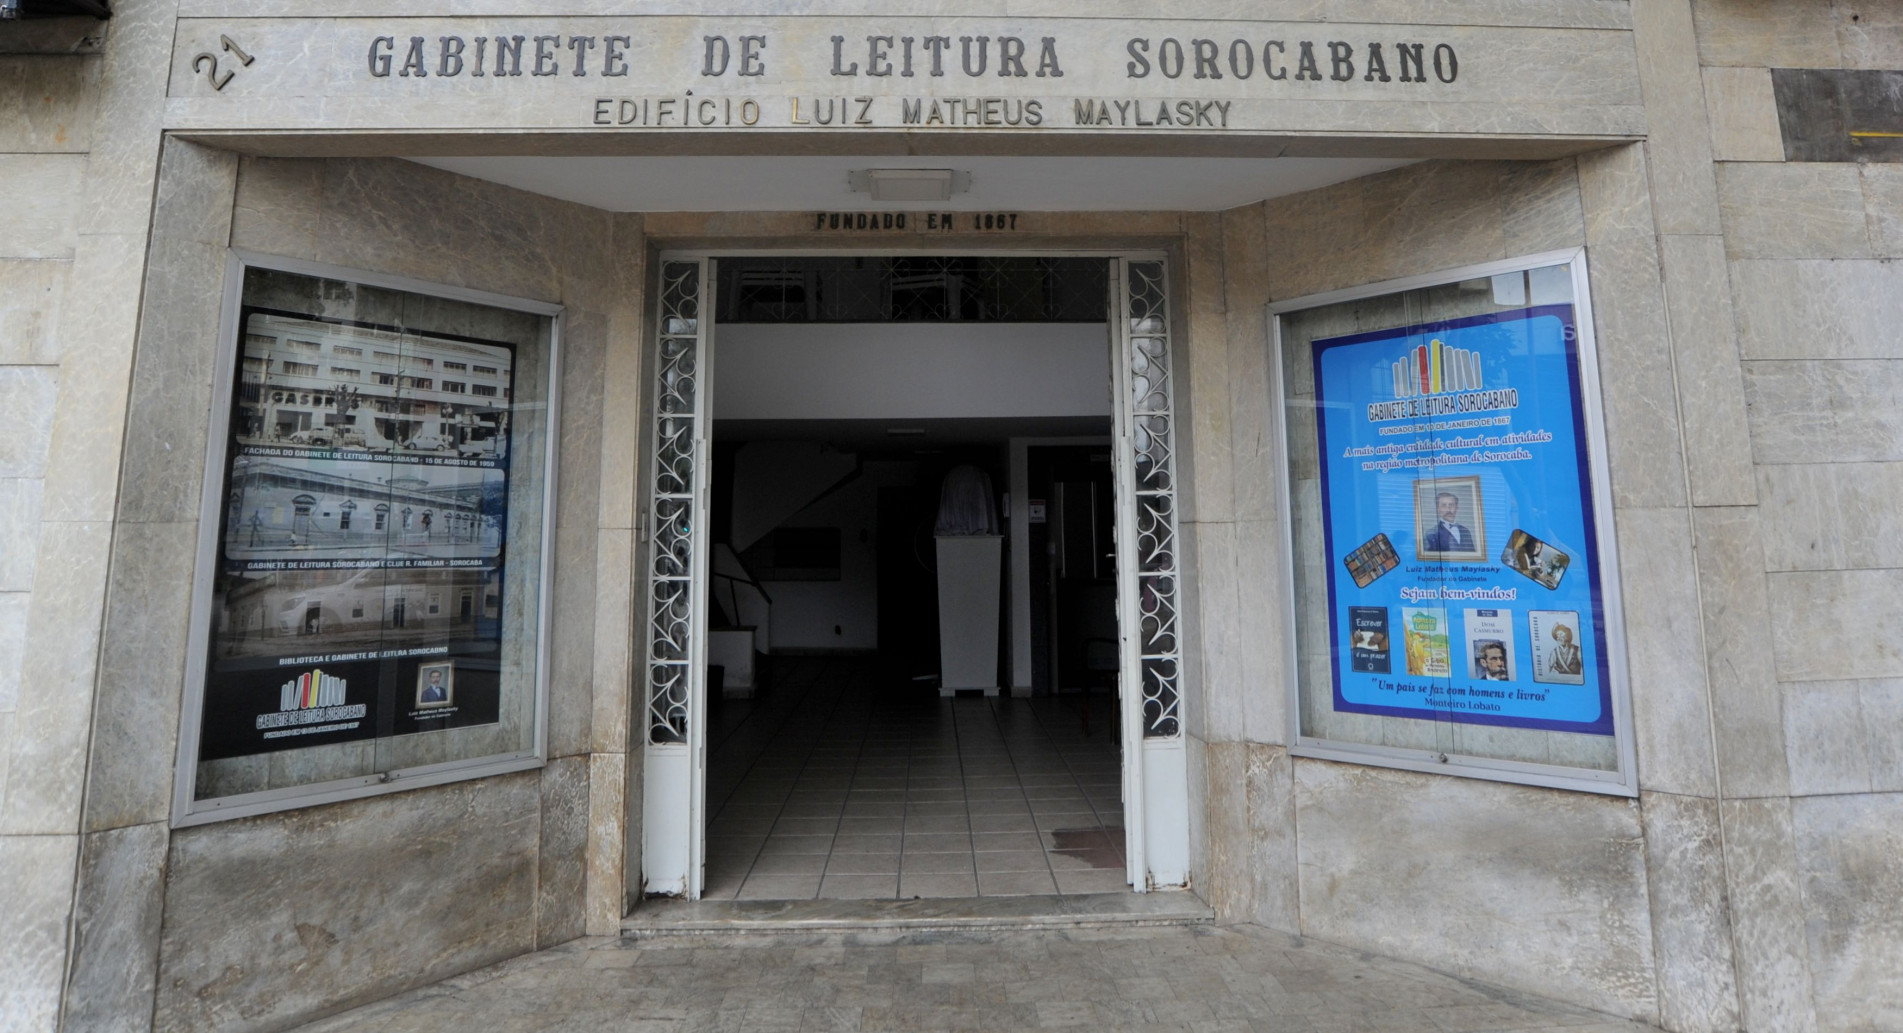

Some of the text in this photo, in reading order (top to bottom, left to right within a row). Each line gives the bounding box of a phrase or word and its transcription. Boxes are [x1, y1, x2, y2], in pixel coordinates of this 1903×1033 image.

[191, 33, 255, 91] 21
[367, 35, 1459, 84] GABINETE DE LEITURA SOROCABANO
[593, 89, 1233, 128] EDIFÍCIO LUIZ MATHEUS MAYLASKY
[816, 213, 1018, 230] FUNDADO EM 1867
[1368, 389, 1518, 421] GABINETE DE LEITURA SOROCABANO
[1379, 425, 1413, 435] FUNDADO
[1414, 424, 1425, 432] EM
[1436, 422, 1446, 430] DE
[1448, 420, 1479, 429] JANEIRO
[1343, 430, 1552, 458] A mais antiga entidade cultural em atividades
[244, 447, 280, 455] FACHADA
[294, 450, 331, 459] GABINETE
[343, 452, 373, 461] LEITURA
[1362, 448, 1532, 473] na região metropolitana de Sorocaba.
[247, 561, 288, 569] GABINETE
[288, 561, 298, 569] DE
[299, 561, 331, 569] LEITURA
[332, 560, 380, 568] SOROCABANO
[449, 559, 483, 567] SOROCABA
[1405, 565, 1500, 574] Luiz Matheus Maylasky
[1400, 585, 1517, 603] Sejam bem-vindos!
[279, 655, 324, 666] BIBLIOTECA
[331, 652, 367, 662] GABINETE
[1418, 685, 1428, 693] se
[1429, 683, 1444, 696] faz
[1446, 687, 1466, 696] com
[1468, 685, 1505, 699] homens
[1424, 697, 1501, 712] Monteiro Lobato
[256, 703, 367, 730] GABINETE DE LEITURA SOROCABANO
